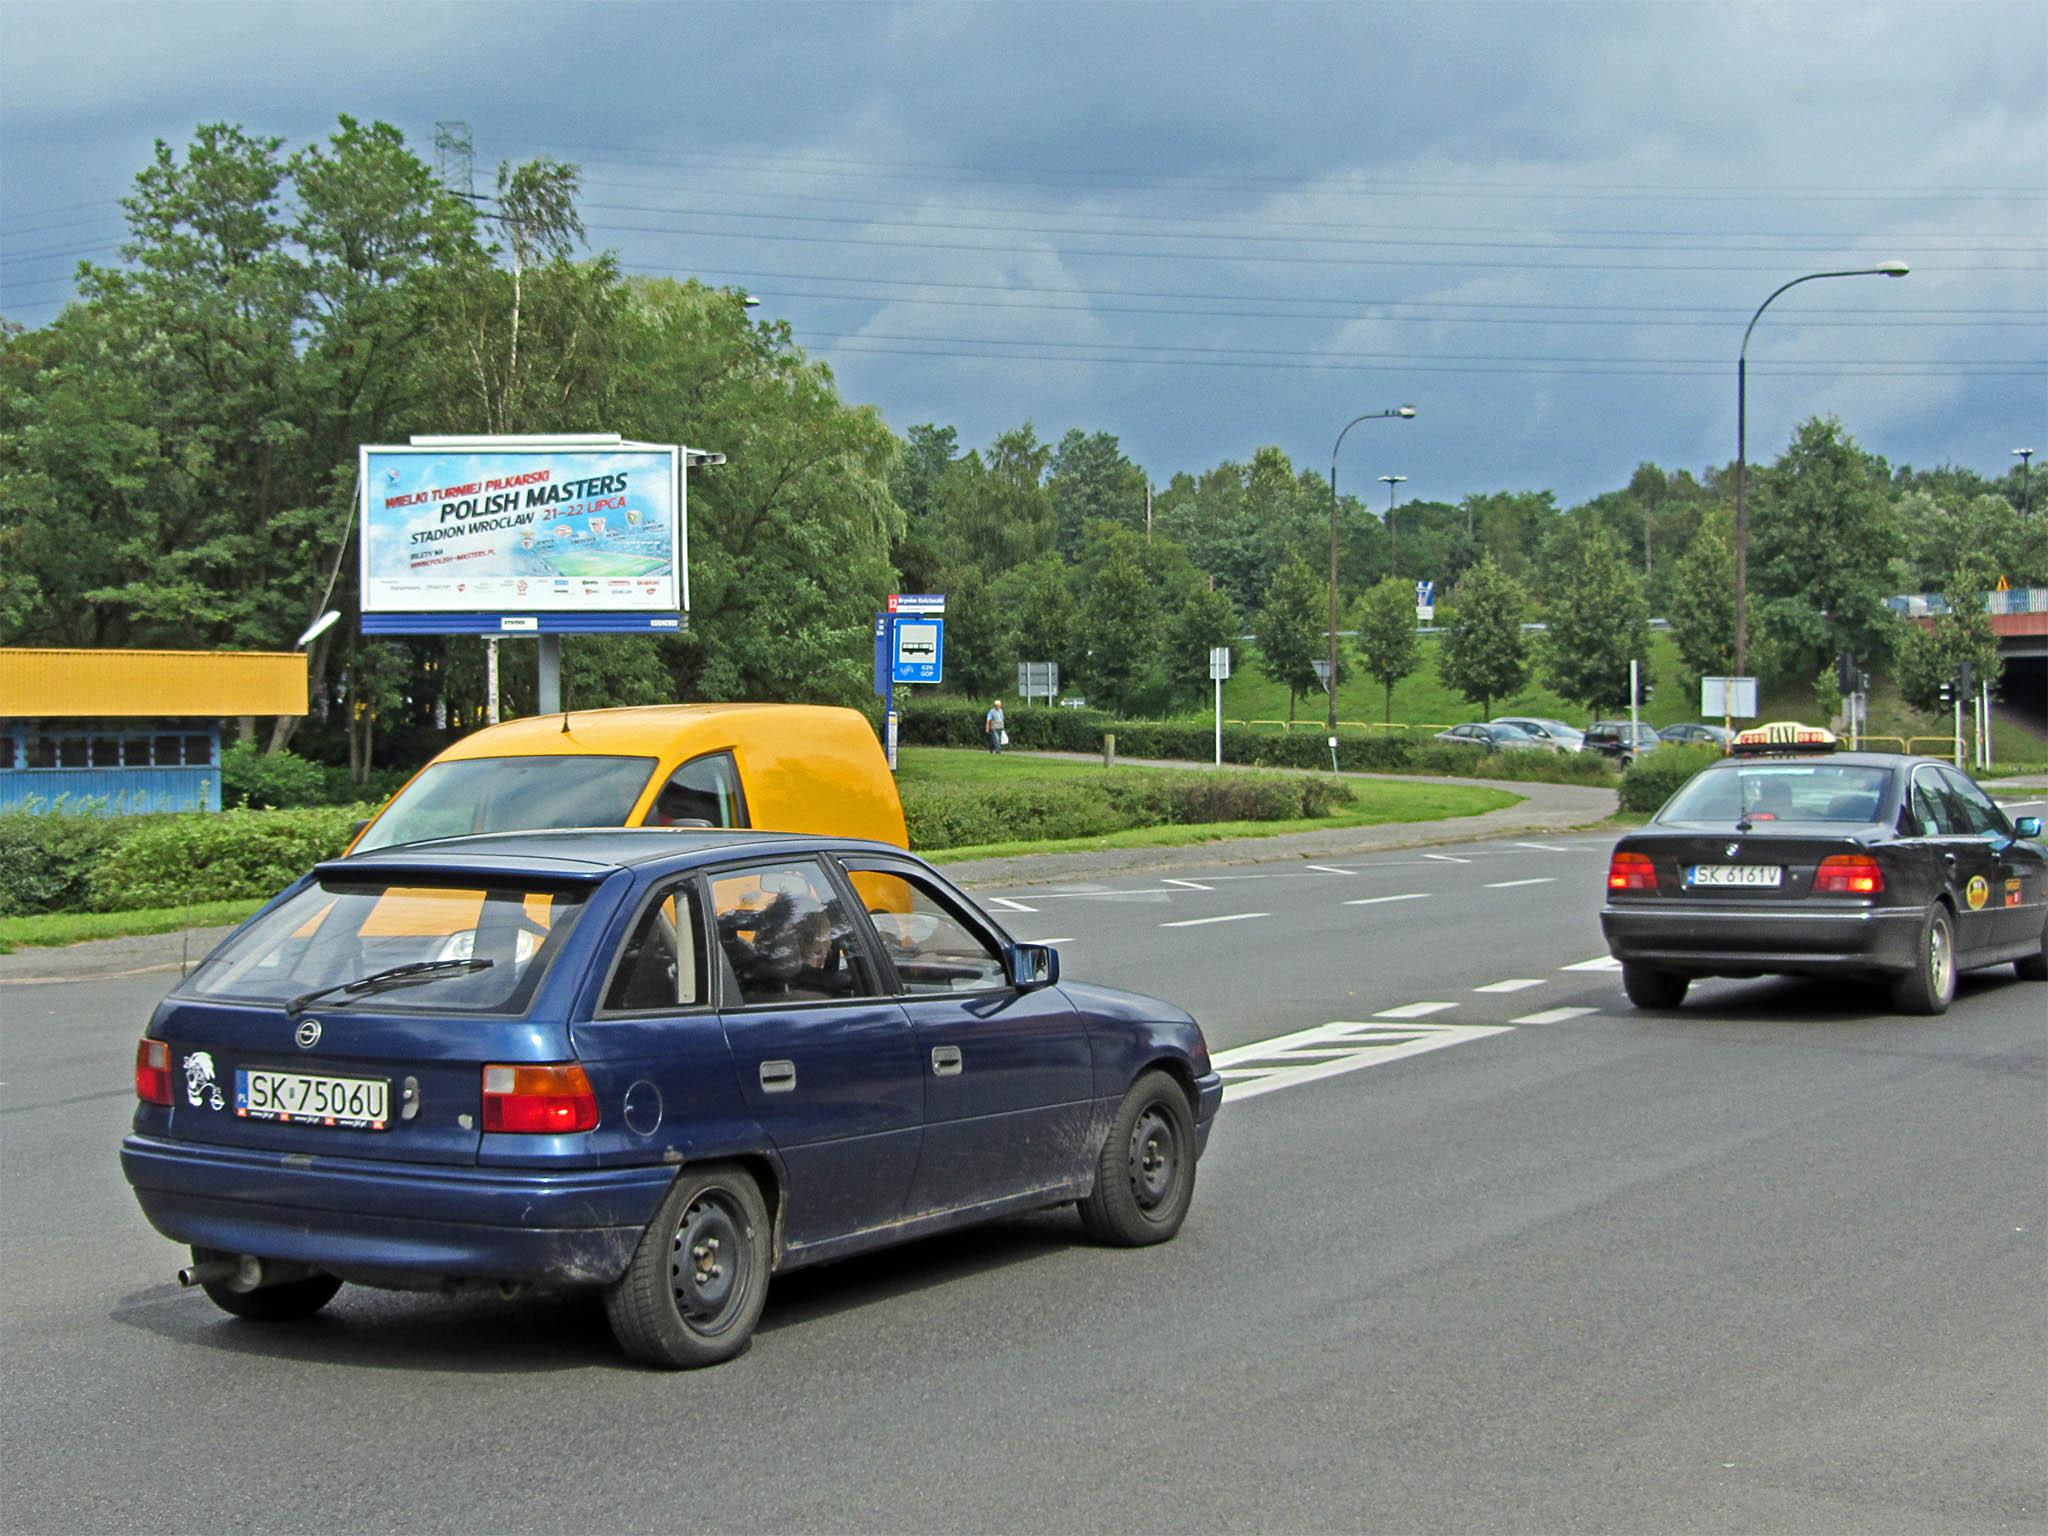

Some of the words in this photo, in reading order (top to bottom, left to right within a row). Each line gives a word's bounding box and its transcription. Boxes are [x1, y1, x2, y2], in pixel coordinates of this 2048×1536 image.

[385, 491, 429, 509] WIELKI
[431, 482, 482, 502] TURNIEJ
[485, 470, 550, 492] PIŁKARSKI
[440, 491, 520, 523] POLISH
[525, 472, 628, 508] MASTERS
[587, 496, 626, 513] LIPCA
[410, 525, 465, 545] STADION
[468, 512, 535, 535] WROCŁAW
[1769, 726, 1796, 744] TAXI
[1698, 866, 1720, 883] SK
[1726, 867, 1779, 883] 6161V
[252, 1075, 287, 1110] SK
[298, 1079, 383, 1118] 7506U
